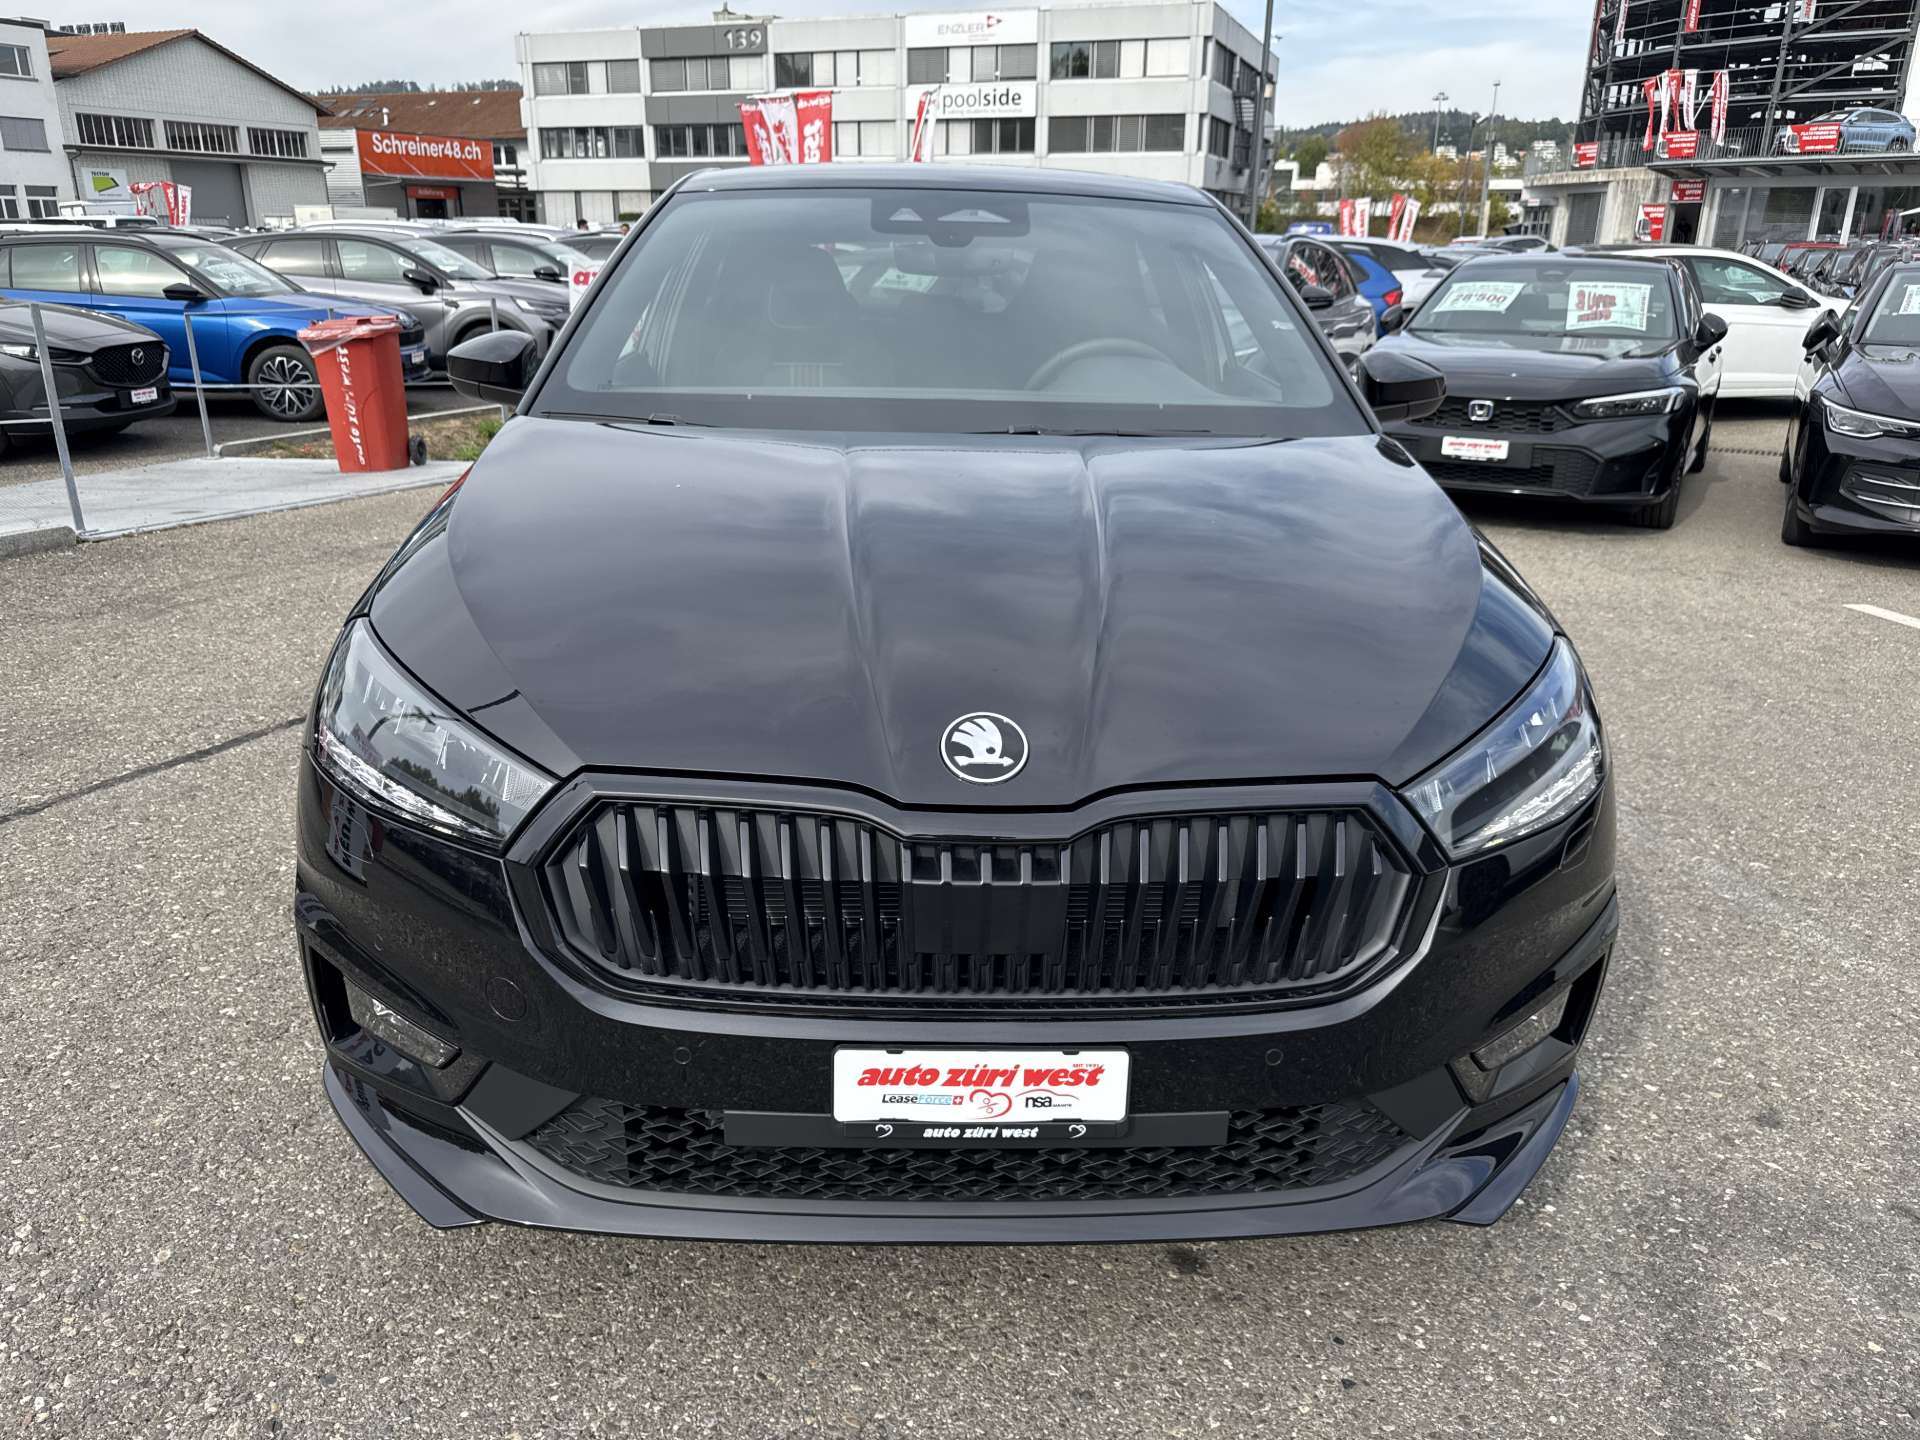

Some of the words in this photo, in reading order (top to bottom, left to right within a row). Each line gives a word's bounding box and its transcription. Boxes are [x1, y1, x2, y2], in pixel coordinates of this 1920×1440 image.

[937, 22, 985, 35] ENZLER
[724, 28, 762, 49] 139
[943, 87, 1022, 114] poolside
[371, 132, 482, 160] Schreiner48.ch
[857, 1064, 940, 1086] auto
[941, 1064, 1021, 1087] züri
[1023, 1064, 1105, 1087] west
[881, 1093, 952, 1105] LeaseForce
[1025, 1095, 1052, 1107] nsa
[923, 1127, 960, 1138] auto
[962, 1126, 998, 1138] züri
[1001, 1127, 1039, 1138] west
